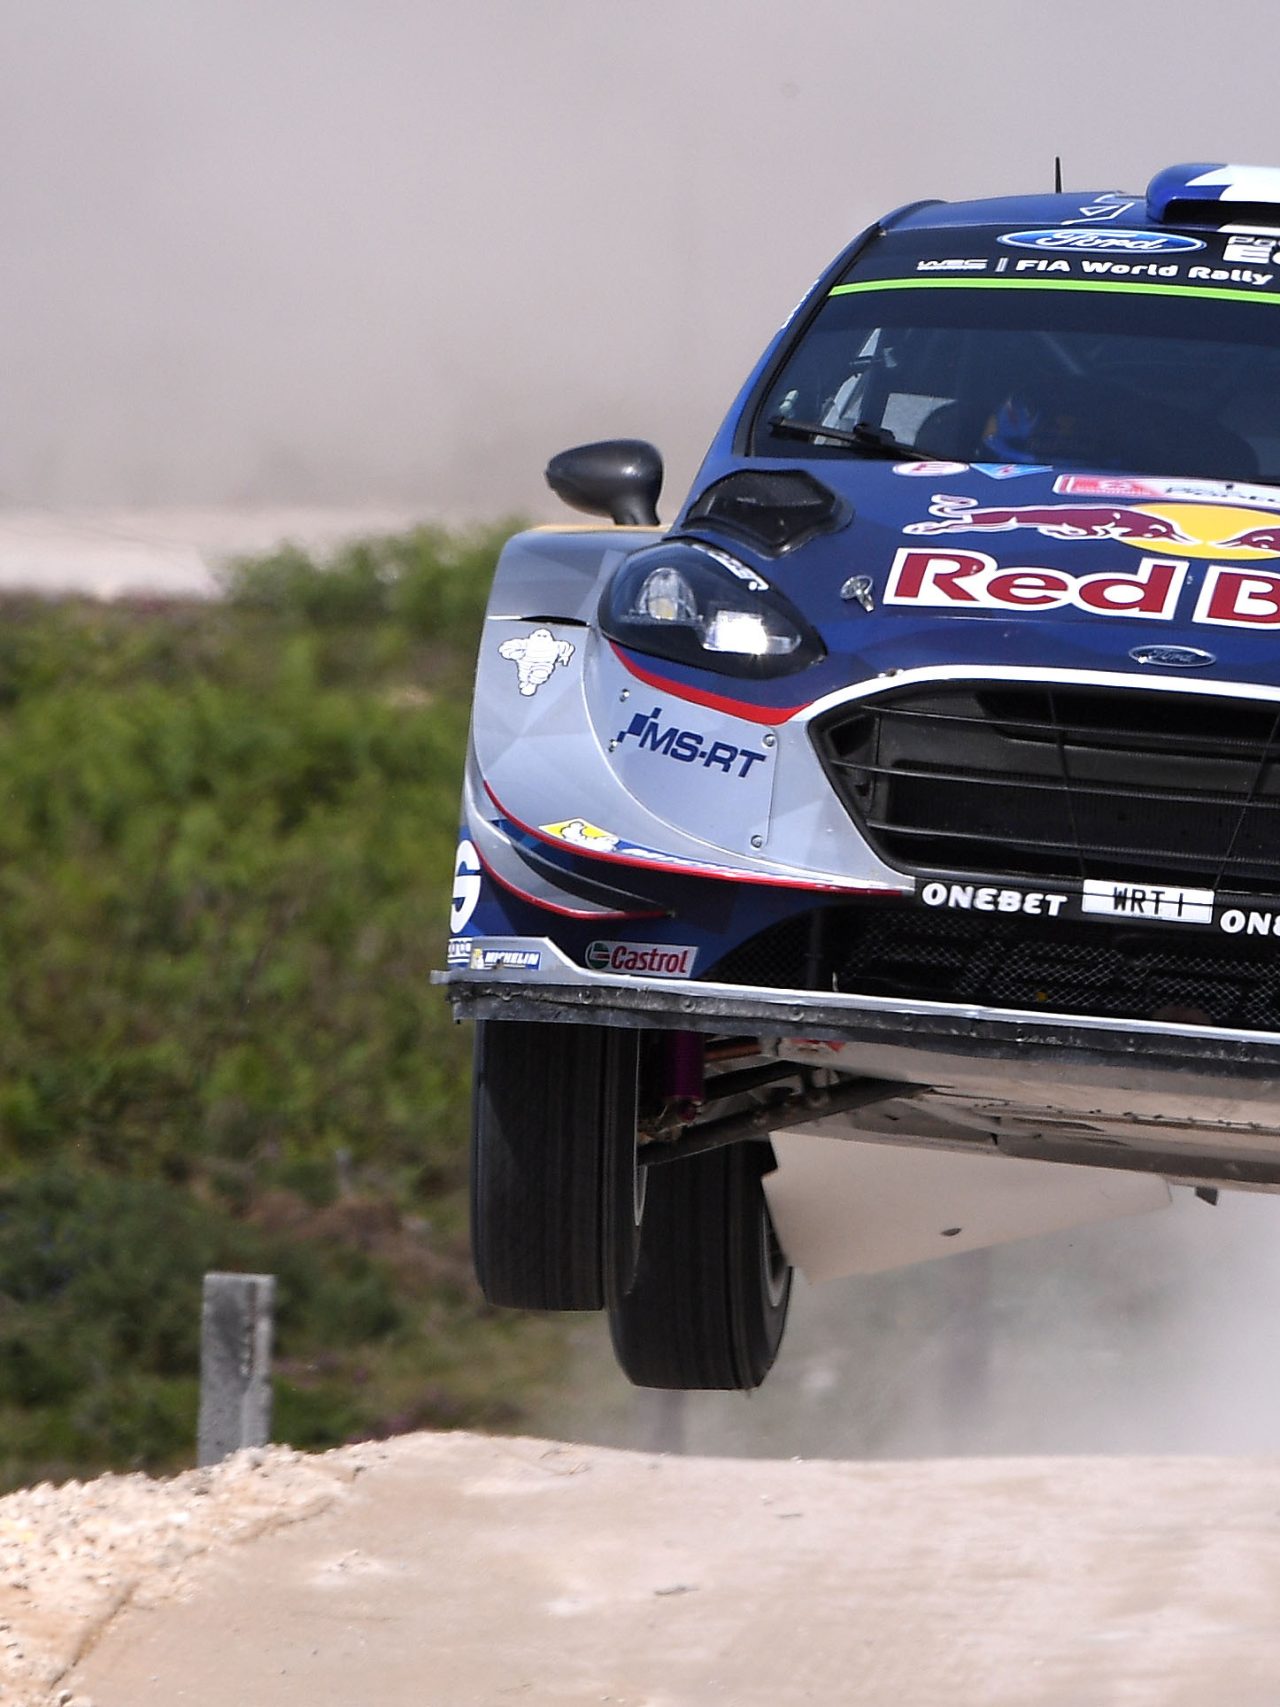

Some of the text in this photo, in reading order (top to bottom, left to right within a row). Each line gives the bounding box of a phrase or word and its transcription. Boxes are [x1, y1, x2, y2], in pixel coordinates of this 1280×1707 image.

[1033, 231, 1168, 250] Ford
[1015, 259, 1071, 273] FIA
[1080, 259, 1179, 277] World
[1187, 265, 1274, 286] Rally
[890, 550, 1180, 616] Red
[638, 719, 767, 779] MS-RT
[921, 882, 1068, 917] ONEBET
[1113, 886, 1166, 915] WRT
[611, 944, 689, 974] Castrol
